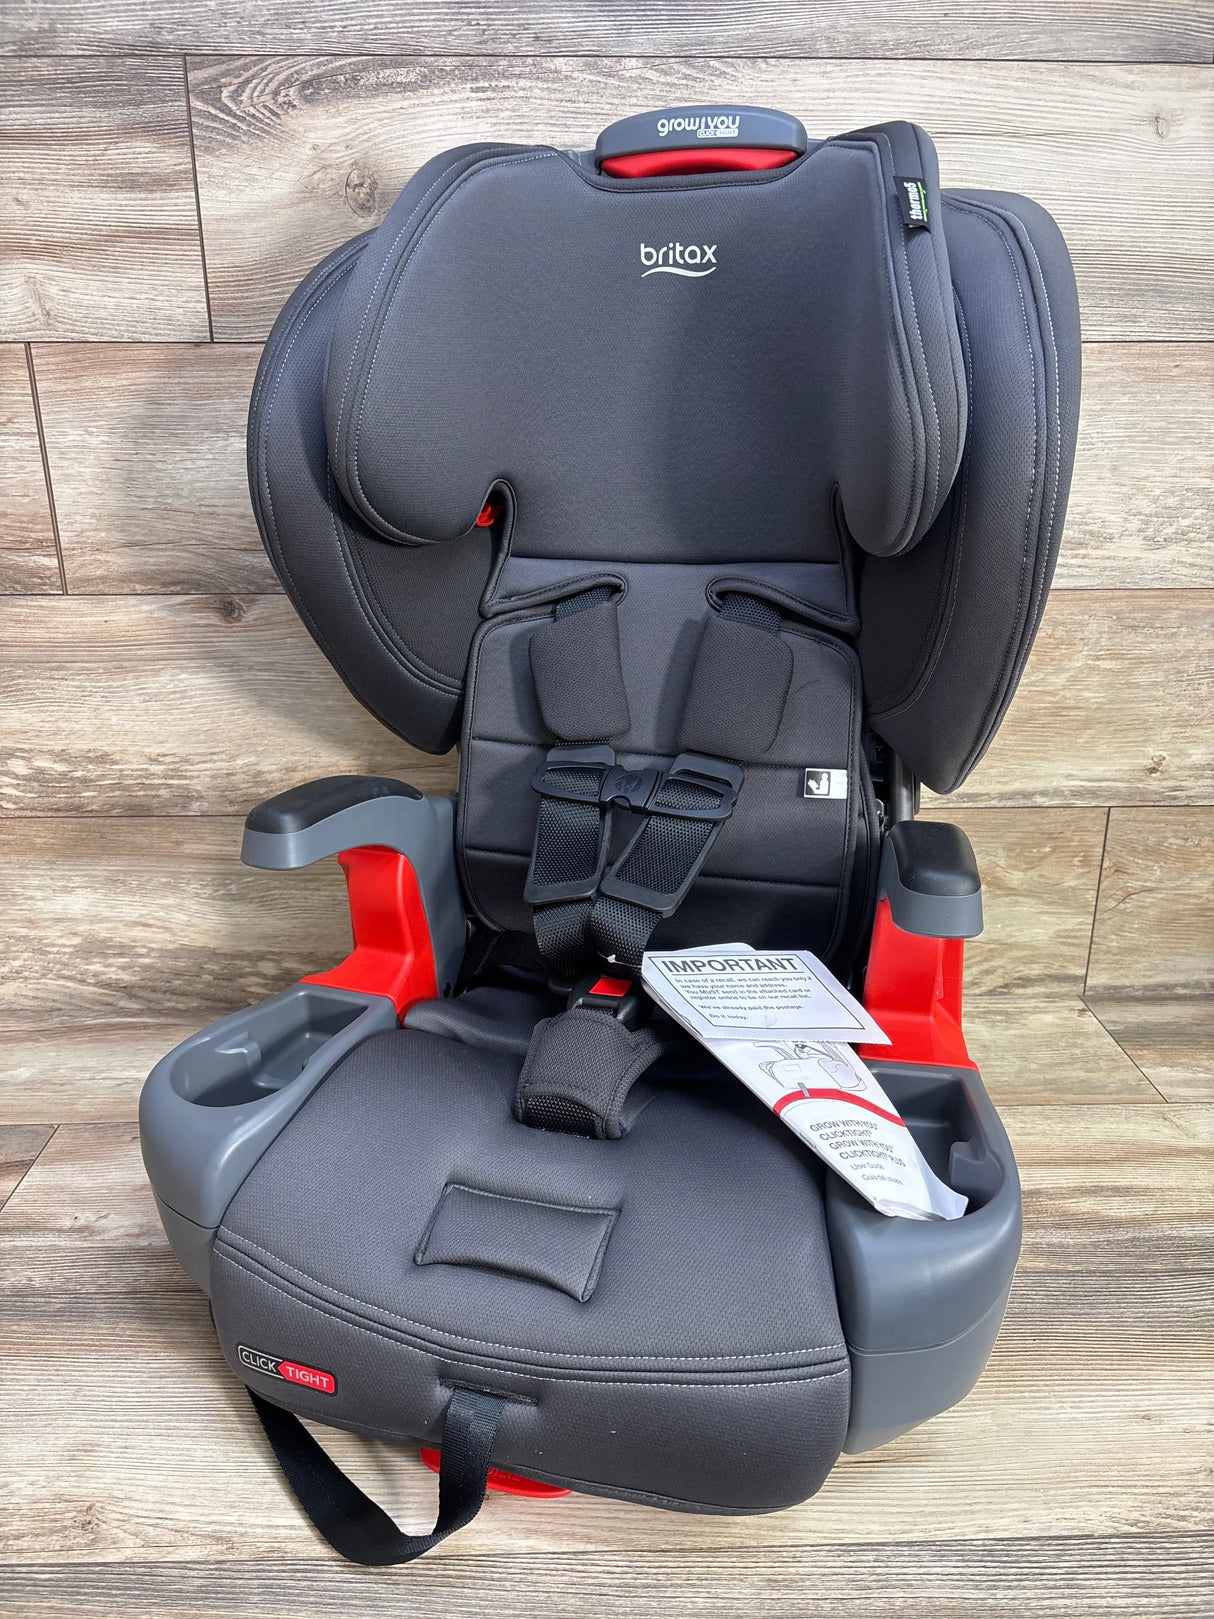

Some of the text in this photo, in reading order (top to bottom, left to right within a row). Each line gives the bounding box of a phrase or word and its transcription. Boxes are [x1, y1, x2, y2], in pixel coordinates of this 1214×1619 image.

[657, 118, 700, 137] grow
[904, 182, 922, 220] thermo5
[640, 242, 718, 266] britax
[661, 958, 798, 972] IMPORTANT
[810, 1120, 840, 1132] GROW
[840, 1120, 864, 1128] WITH
[829, 1140, 860, 1150] GROW
[857, 1140, 882, 1148] WITH
[242, 1352, 330, 1388] CLICK TIGHT
